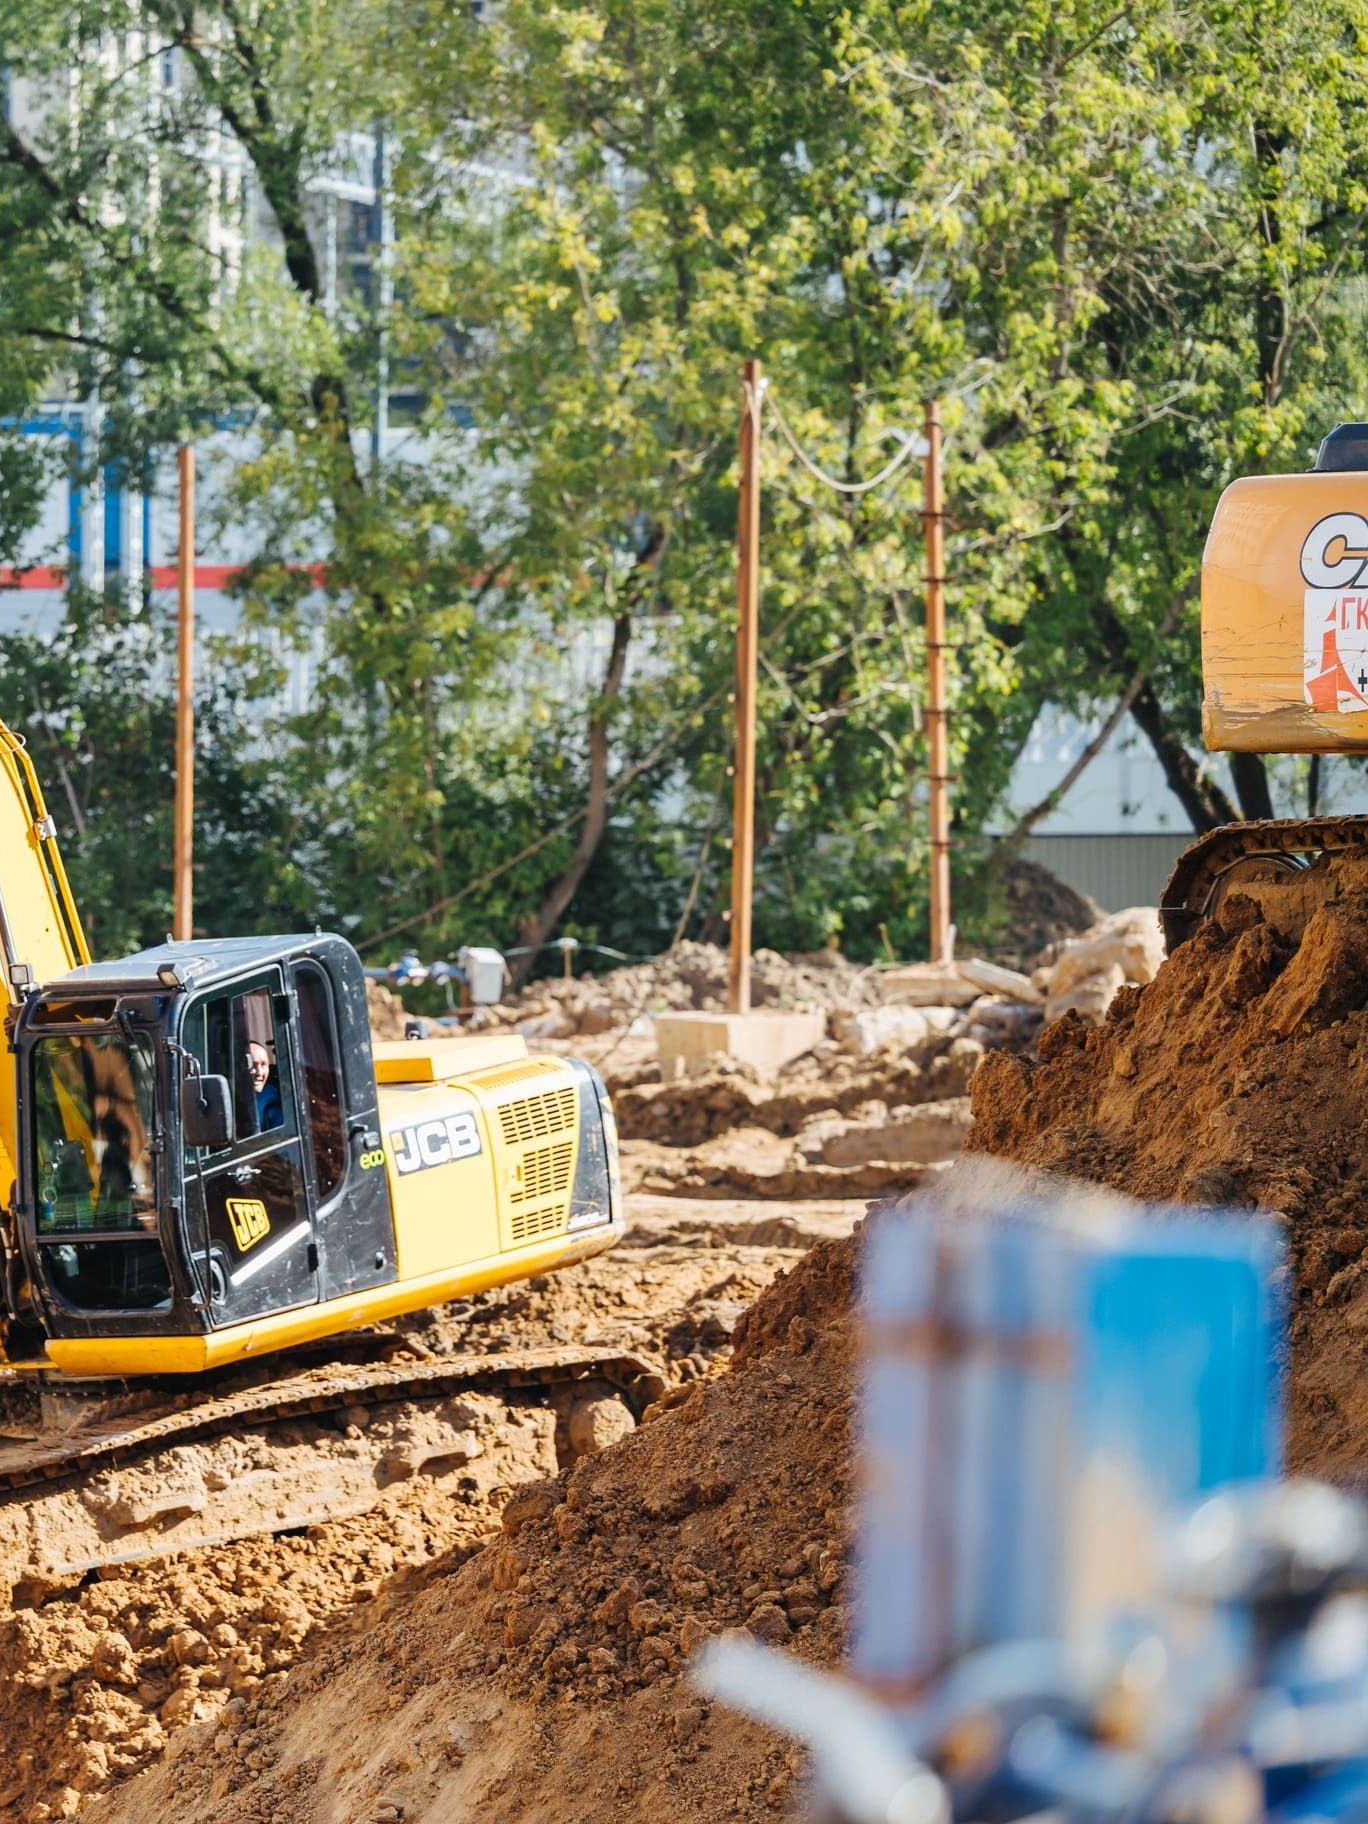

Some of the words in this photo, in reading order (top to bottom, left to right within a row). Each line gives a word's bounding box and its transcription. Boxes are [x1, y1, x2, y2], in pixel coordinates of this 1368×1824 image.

[1299, 511, 1368, 589] C
[359, 1149, 385, 1170] eco
[395, 1113, 482, 1173] JCB
[232, 1203, 267, 1245] JCB
